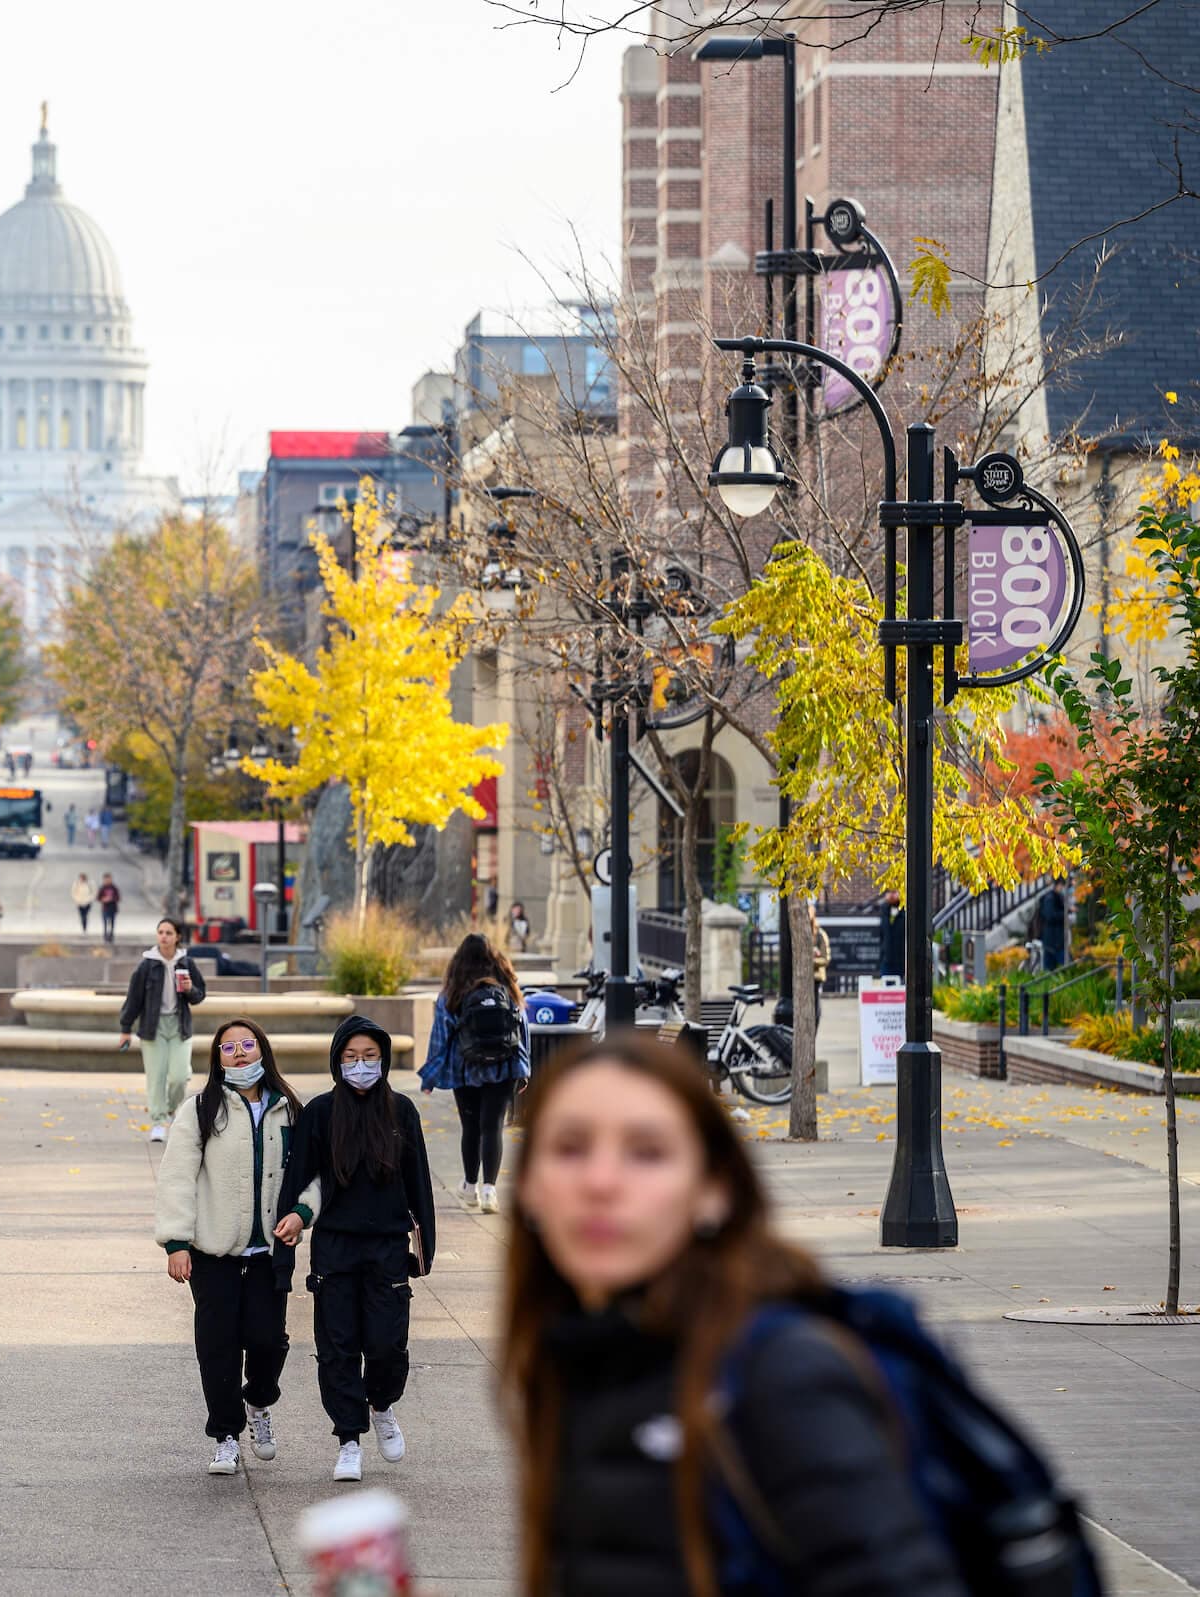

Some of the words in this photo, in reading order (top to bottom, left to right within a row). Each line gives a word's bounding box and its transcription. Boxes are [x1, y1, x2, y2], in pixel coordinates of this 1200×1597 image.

[845, 269, 882, 381] 800
[971, 551, 997, 648] BLOCK
[1001, 526, 1050, 648] 800
